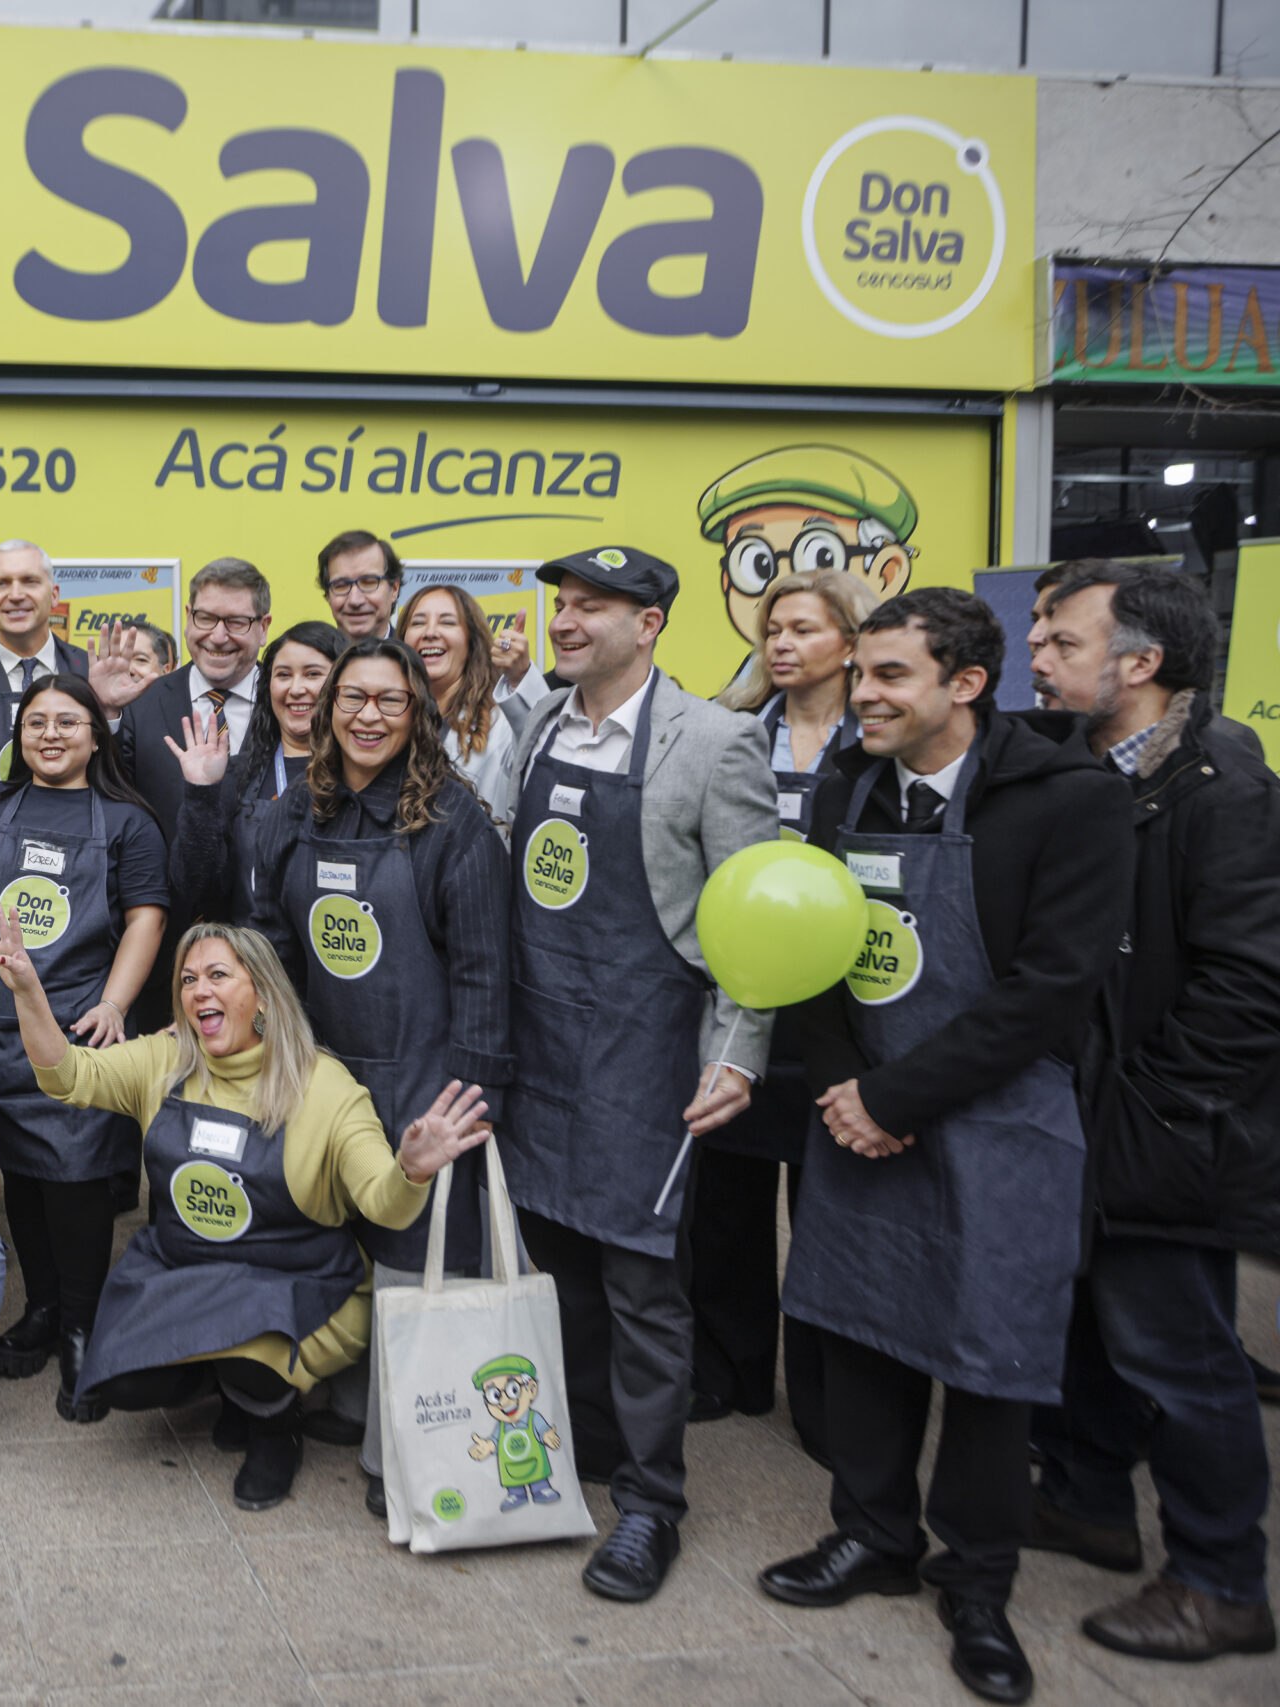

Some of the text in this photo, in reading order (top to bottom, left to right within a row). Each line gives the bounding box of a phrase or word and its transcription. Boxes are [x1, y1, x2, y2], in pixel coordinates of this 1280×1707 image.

[13, 64, 764, 340] Salva
[858, 171, 951, 217] Don
[842, 218, 964, 266] Salva
[856, 270, 953, 290] cencosud
[1053, 279, 1280, 373] ULUA
[154, 423, 622, 499] Acá sí alcanza
[57, 568, 98, 579] AHORRO
[100, 568, 133, 580] DIARIO
[415, 571, 500, 583] TU AHORRO DIARIO
[1247, 699, 1280, 720] Ac
[27, 851, 60, 867] KAREN
[542, 838, 573, 863] Don
[533, 857, 575, 885] Salva
[17, 891, 53, 911] Don
[8, 909, 55, 928] alva
[324, 913, 359, 932] Don
[321, 932, 366, 952] Salva
[865, 929, 893, 948] on
[854, 947, 899, 973] alva
[190, 1179, 228, 1200] Don
[186, 1195, 236, 1218] Salva
[415, 1390, 442, 1408] Acá
[416, 1406, 471, 1424] alcanza
